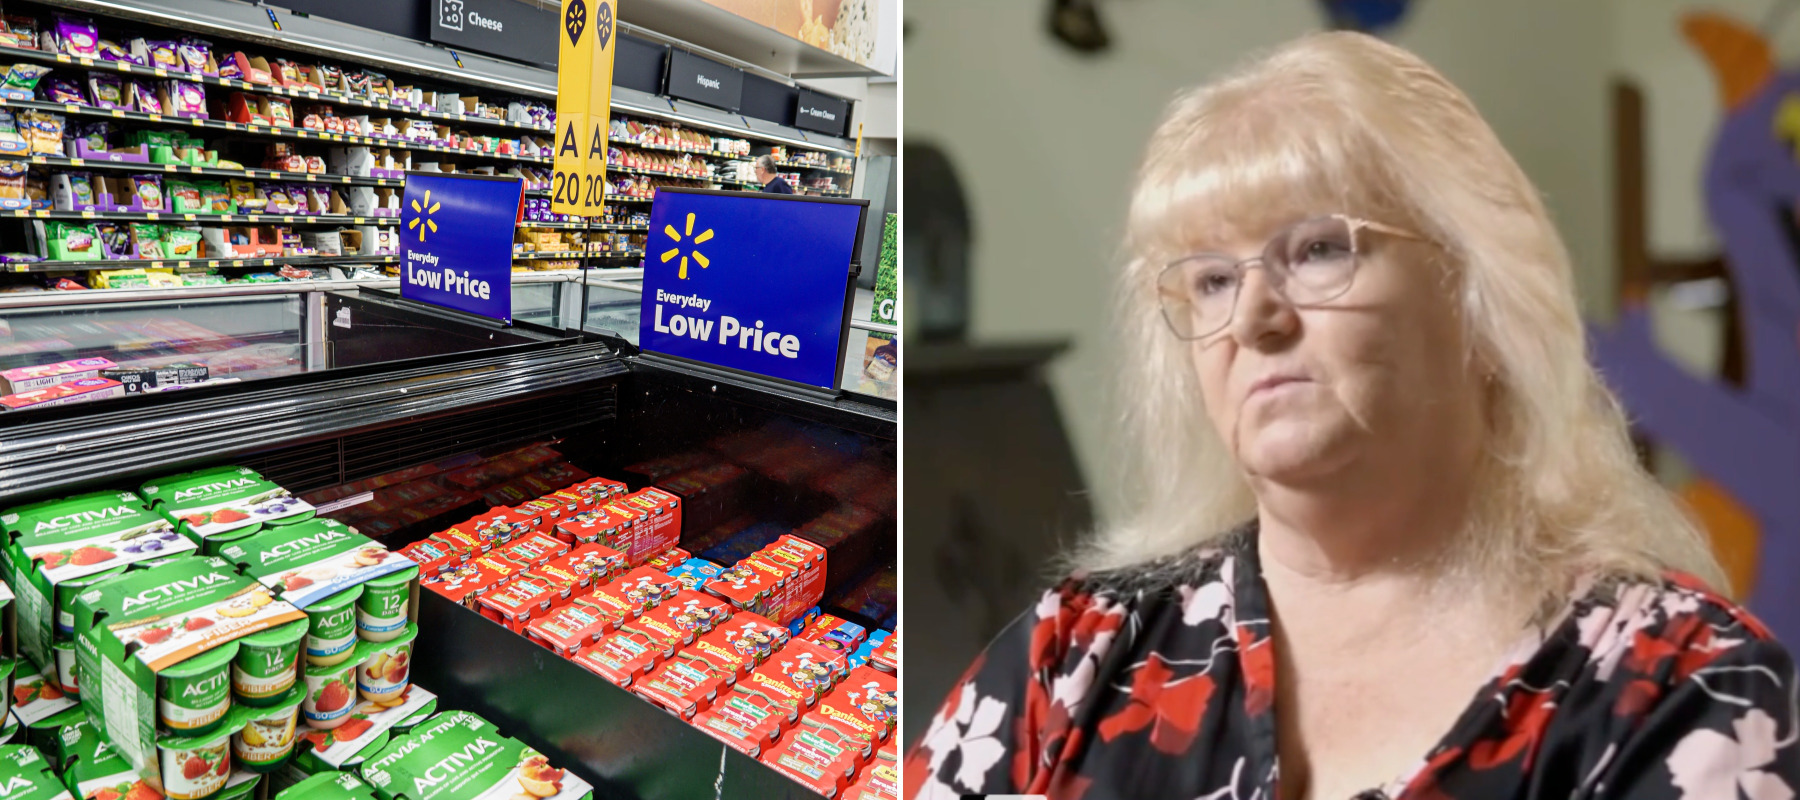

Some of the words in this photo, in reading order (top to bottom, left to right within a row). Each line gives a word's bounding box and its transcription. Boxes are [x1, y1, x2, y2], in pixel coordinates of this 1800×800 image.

[468, 11, 503, 32] Cheese
[696, 74, 721, 90] Hispanic
[810, 107, 823, 118] Cream
[822, 109, 836, 121] Cheese
[559, 120, 578, 158] A
[588, 123, 603, 160] A
[553, 171, 580, 206] 20
[585, 173, 604, 207] 20
[407, 249, 440, 267] Everyday
[407, 261, 442, 290] Low
[444, 268, 491, 300] Price
[656, 288, 712, 313] Everyday
[653, 303, 714, 342] Low
[718, 315, 801, 359] Price
[36, 377, 55, 386] LIGHT
[174, 476, 256, 501] ACTIVIA
[34, 505, 137, 534] ACTIVIA
[260, 530, 346, 563] ACTIVIA
[122, 571, 230, 612] ACTIVIA
[382, 594, 400, 610] 12
[592, 589, 632, 611] Danimals
[638, 615, 682, 638] Danimals
[266, 646, 284, 668] 12
[324, 646, 339, 655] 60
[696, 640, 743, 664] Danimals
[264, 662, 284, 676] pack
[752, 672, 803, 699] Danimals
[188, 709, 221, 728] FIBER
[315, 712, 328, 720] 60
[420, 710, 469, 744] ACTIVIA
[820, 703, 877, 733] Danimals
[364, 739, 420, 778] ACTIVIA
[413, 736, 498, 796] ACTIVIA
[792, 741, 830, 766] Strawberry
